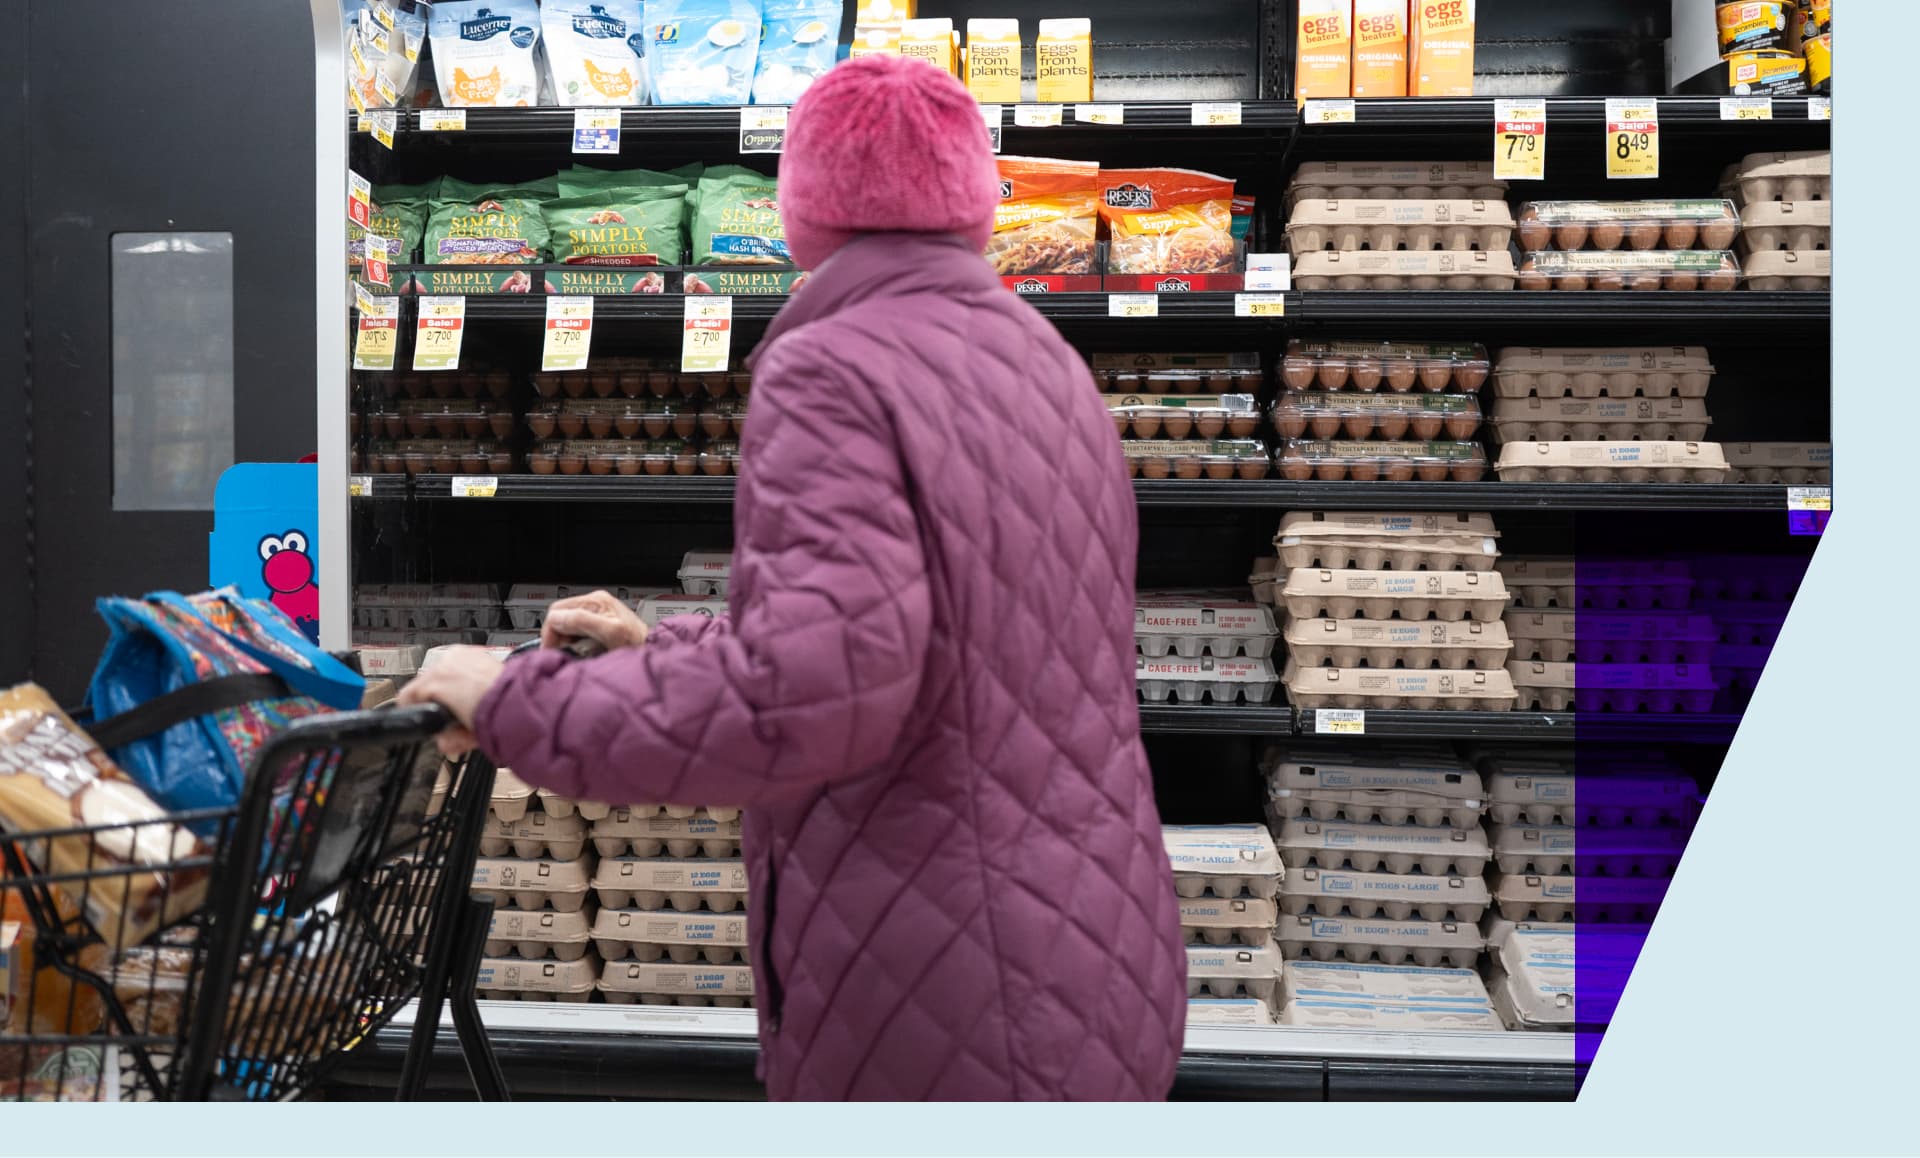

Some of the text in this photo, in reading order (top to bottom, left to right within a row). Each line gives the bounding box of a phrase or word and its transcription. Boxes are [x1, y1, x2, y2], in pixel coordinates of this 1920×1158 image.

[1425, 0, 1463, 20] egg
[463, 18, 510, 35] Lucerne
[574, 18, 624, 34] Lucerne
[1303, 16, 1340, 34] egg
[1359, 14, 1396, 32] egg
[1428, 19, 1464, 29] beaters
[1306, 33, 1340, 44] beaters
[1361, 31, 1397, 42] beaters
[901, 43, 938, 56] Eggs
[971, 44, 1009, 56] Eggs
[1039, 44, 1077, 56] Eggs
[1424, 40, 1471, 49] ORIGINAL
[971, 55, 1008, 66] from
[1040, 55, 1077, 66] from
[1302, 54, 1347, 63] ORIGINAL
[1358, 52, 1403, 61] ORIGINAL
[971, 65, 1019, 77] plants
[1040, 64, 1088, 77] plants
[459, 79, 491, 90] Cage
[593, 74, 622, 85] Cage
[1505, 123, 1536, 131] Sale!
[1617, 121, 1648, 130] Sale!
[451, 214, 522, 231] SIMPLY
[721, 208, 784, 226] SIMPL
[448, 228, 521, 238] POTATOES
[568, 227, 648, 244] SIMPLY
[572, 243, 648, 255] POTATOES
[589, 257, 631, 265] SHREDDED
[432, 272, 494, 285] SIMPLY
[562, 272, 627, 286] SIMPLY
[719, 273, 784, 286] SIMPLY
[427, 319, 454, 327] Sale!
[1612, 454, 1640, 462] LARGE
[1146, 617, 1198, 626] CAGE-FREE
[1391, 634, 1419, 642] LARGE
[1148, 664, 1199, 673] CAGE-FREE
[1399, 684, 1427, 692] LARGE
[1202, 855, 1235, 864] LARGE
[692, 879, 719, 887] LARGE
[1375, 882, 1400, 891] EGGS
[1407, 882, 1440, 892] LARGE
[1187, 907, 1220, 916] LARGE
[686, 931, 714, 939] LARGE
[1365, 926, 1390, 935] EGGS
[1396, 926, 1429, 936] LARGE
[1191, 957, 1225, 967] LARGE
